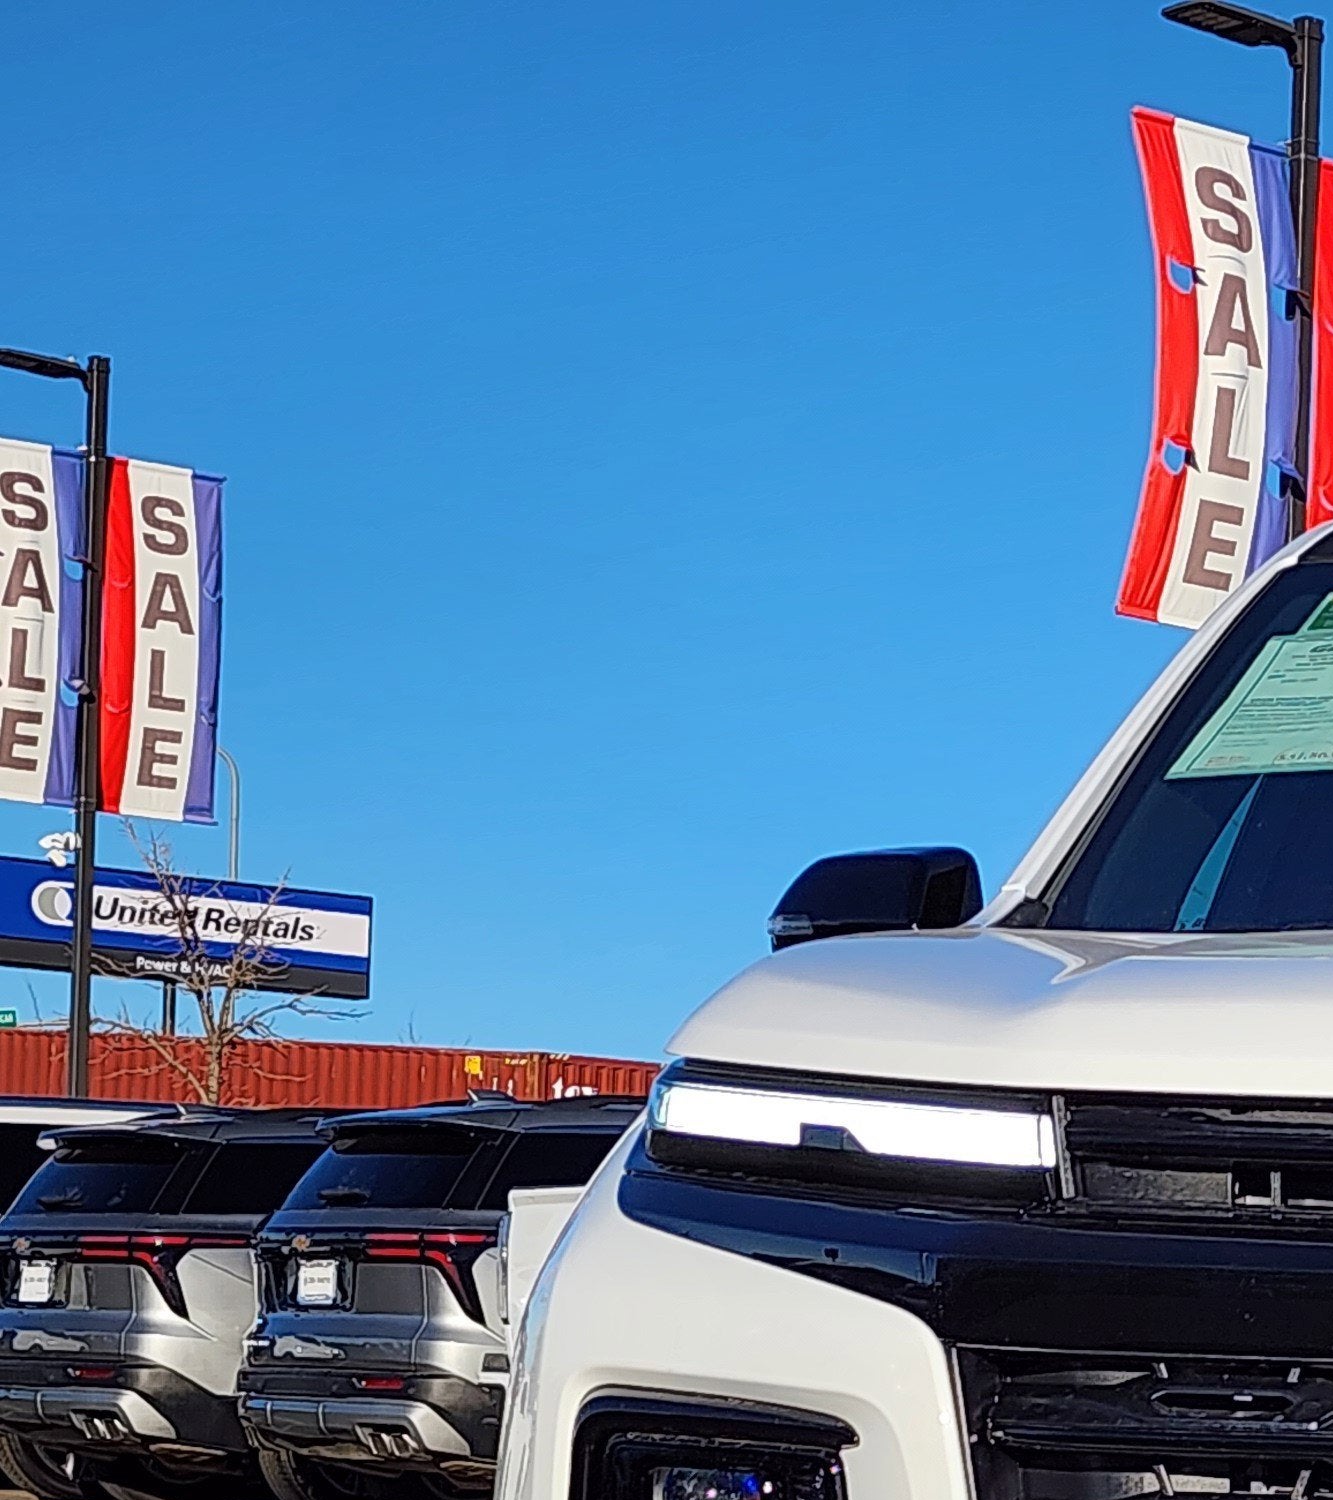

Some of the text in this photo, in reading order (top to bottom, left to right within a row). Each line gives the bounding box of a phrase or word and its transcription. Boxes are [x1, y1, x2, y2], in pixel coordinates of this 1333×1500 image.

[1182, 165, 1262, 592] SALE
[0, 471, 55, 773] SALE
[136, 496, 195, 791] SALE
[136, 956, 178, 973] Power
[202, 907, 315, 941] Rentals
